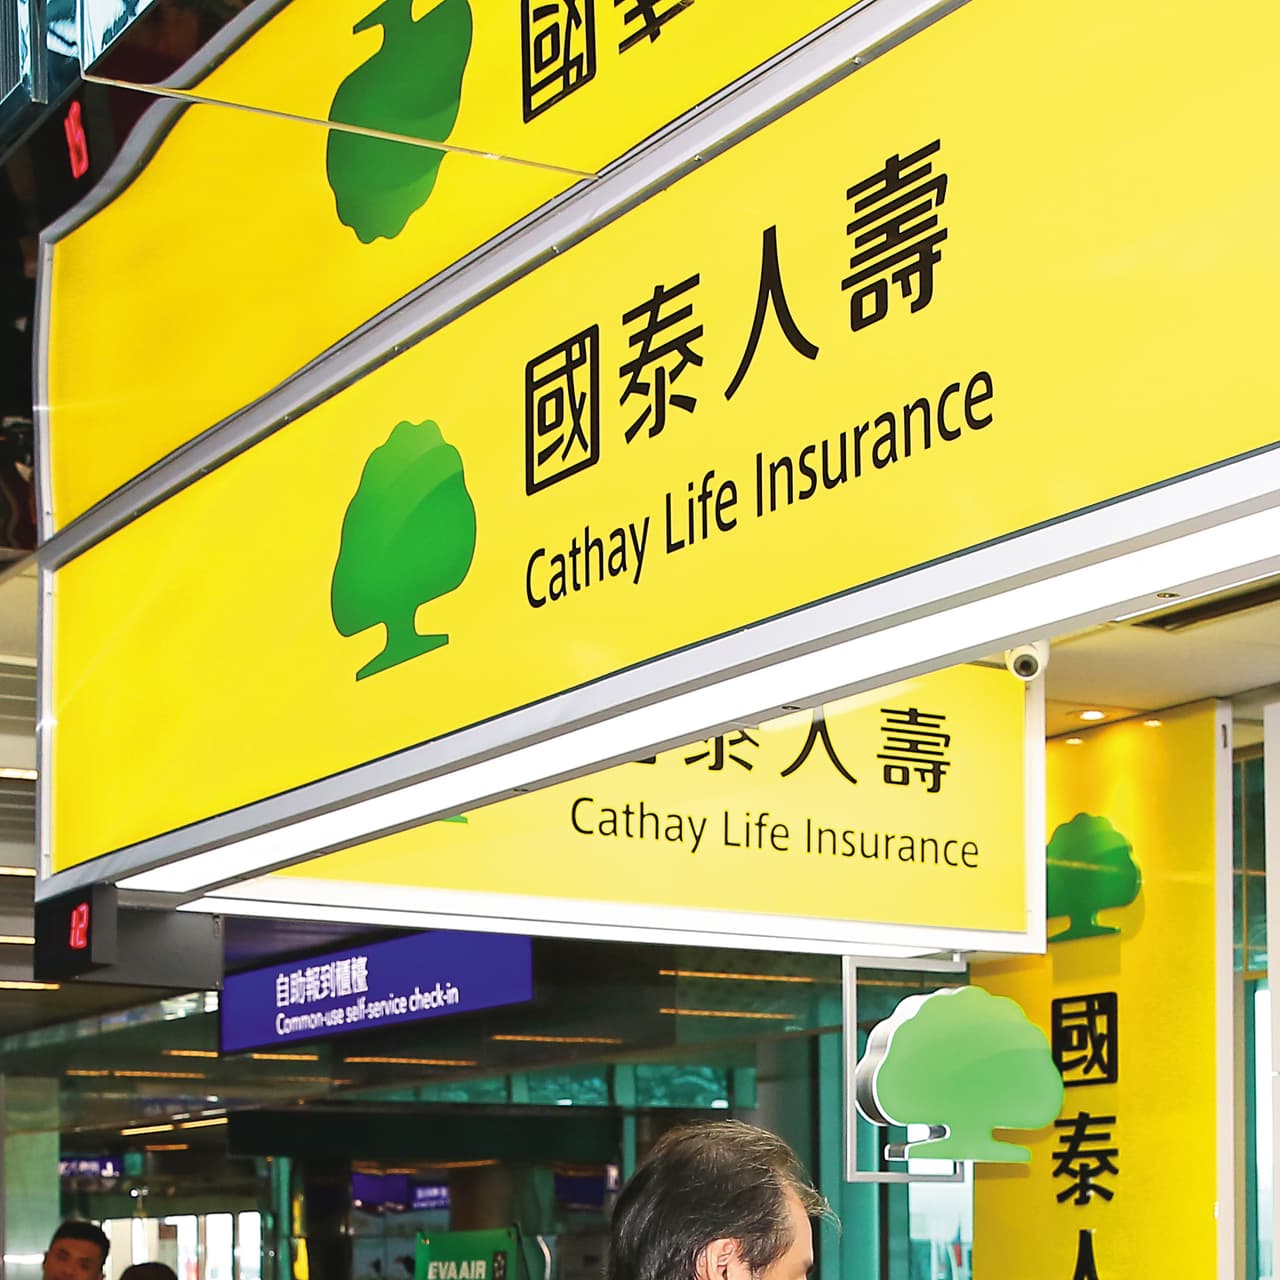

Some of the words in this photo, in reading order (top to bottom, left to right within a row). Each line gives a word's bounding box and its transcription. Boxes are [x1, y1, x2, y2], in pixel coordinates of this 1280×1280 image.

[524, 138, 949, 497] 國泰人壽
[525, 515, 651, 608] Cathay
[664, 472, 738, 556] Life
[755, 370, 994, 518] Insurance
[633, 706, 951, 793] 人壽
[569, 796, 708, 853] Cathay
[723, 809, 790, 852] Life
[806, 818, 979, 869] Insurance
[70, 902, 89, 949] 12
[276, 1008, 345, 1035] Common-use
[345, 993, 407, 1023] self-service
[408, 982, 459, 1013] check-in
